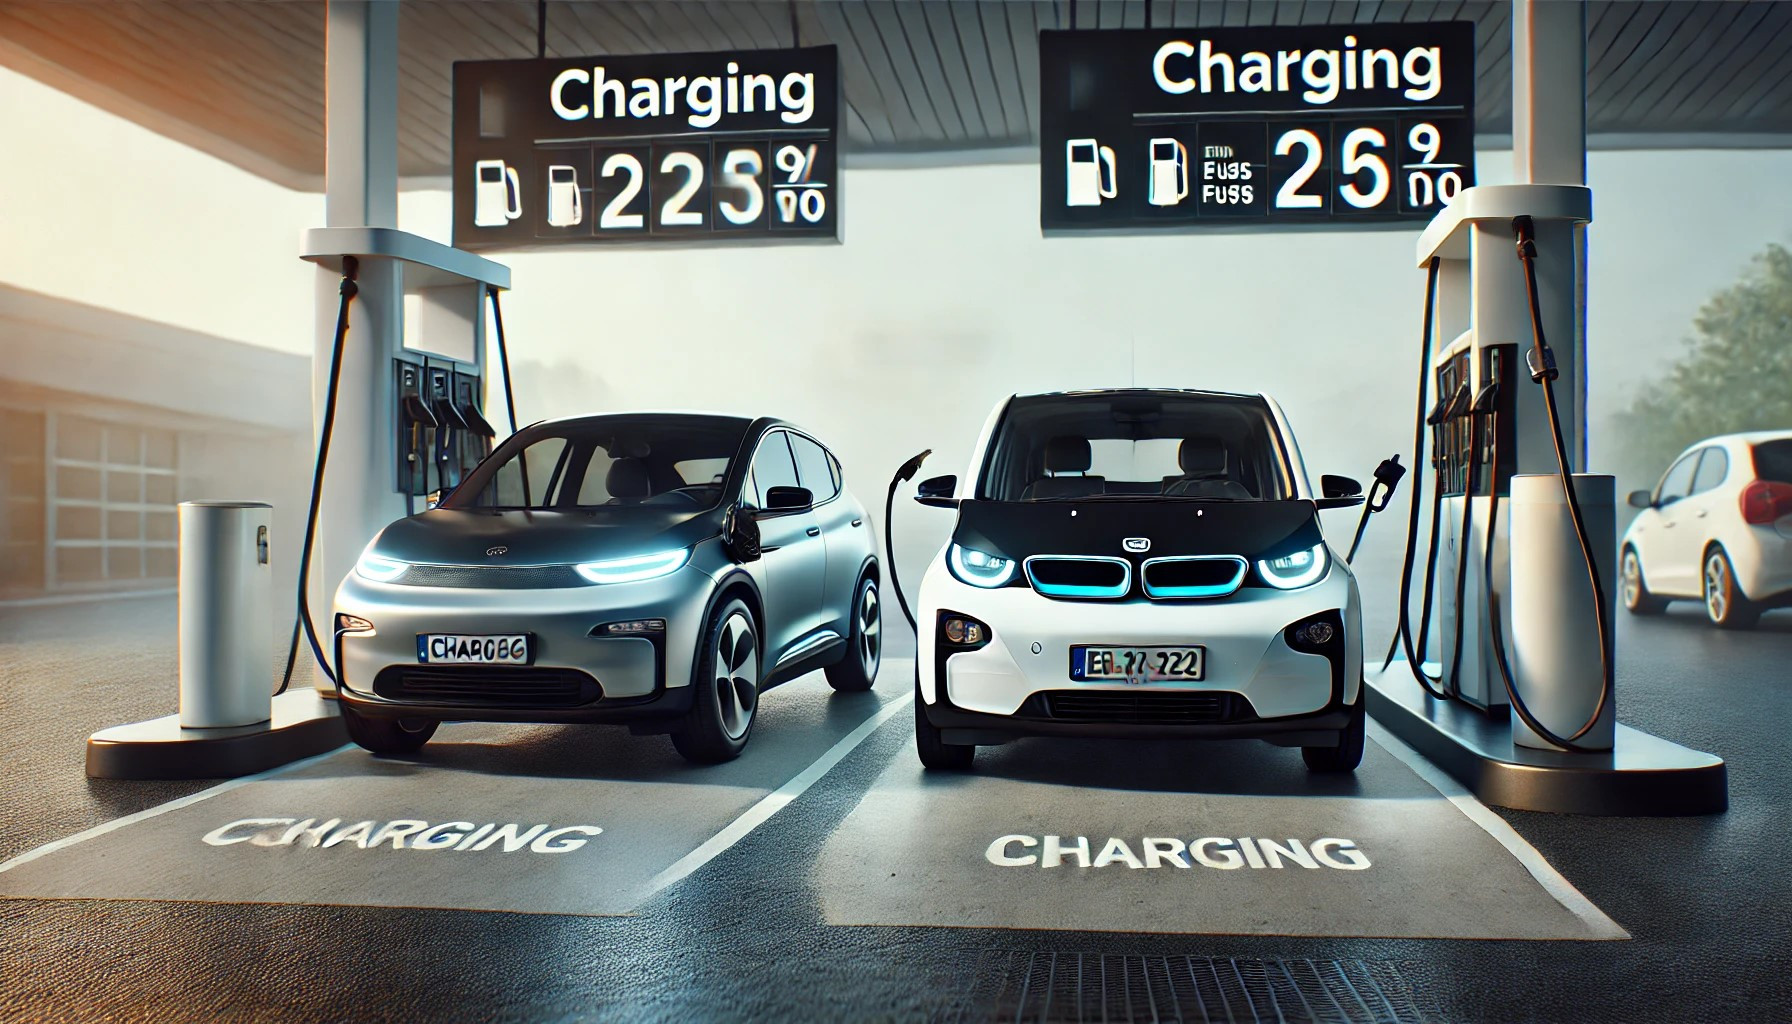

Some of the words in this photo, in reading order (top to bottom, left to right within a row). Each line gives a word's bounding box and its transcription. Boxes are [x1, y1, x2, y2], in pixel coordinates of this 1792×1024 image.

[550, 61, 815, 128] Charging
[1152, 35, 1442, 104] Charging
[202, 817, 603, 854] CHARGING
[984, 834, 1373, 871] CHARGING
